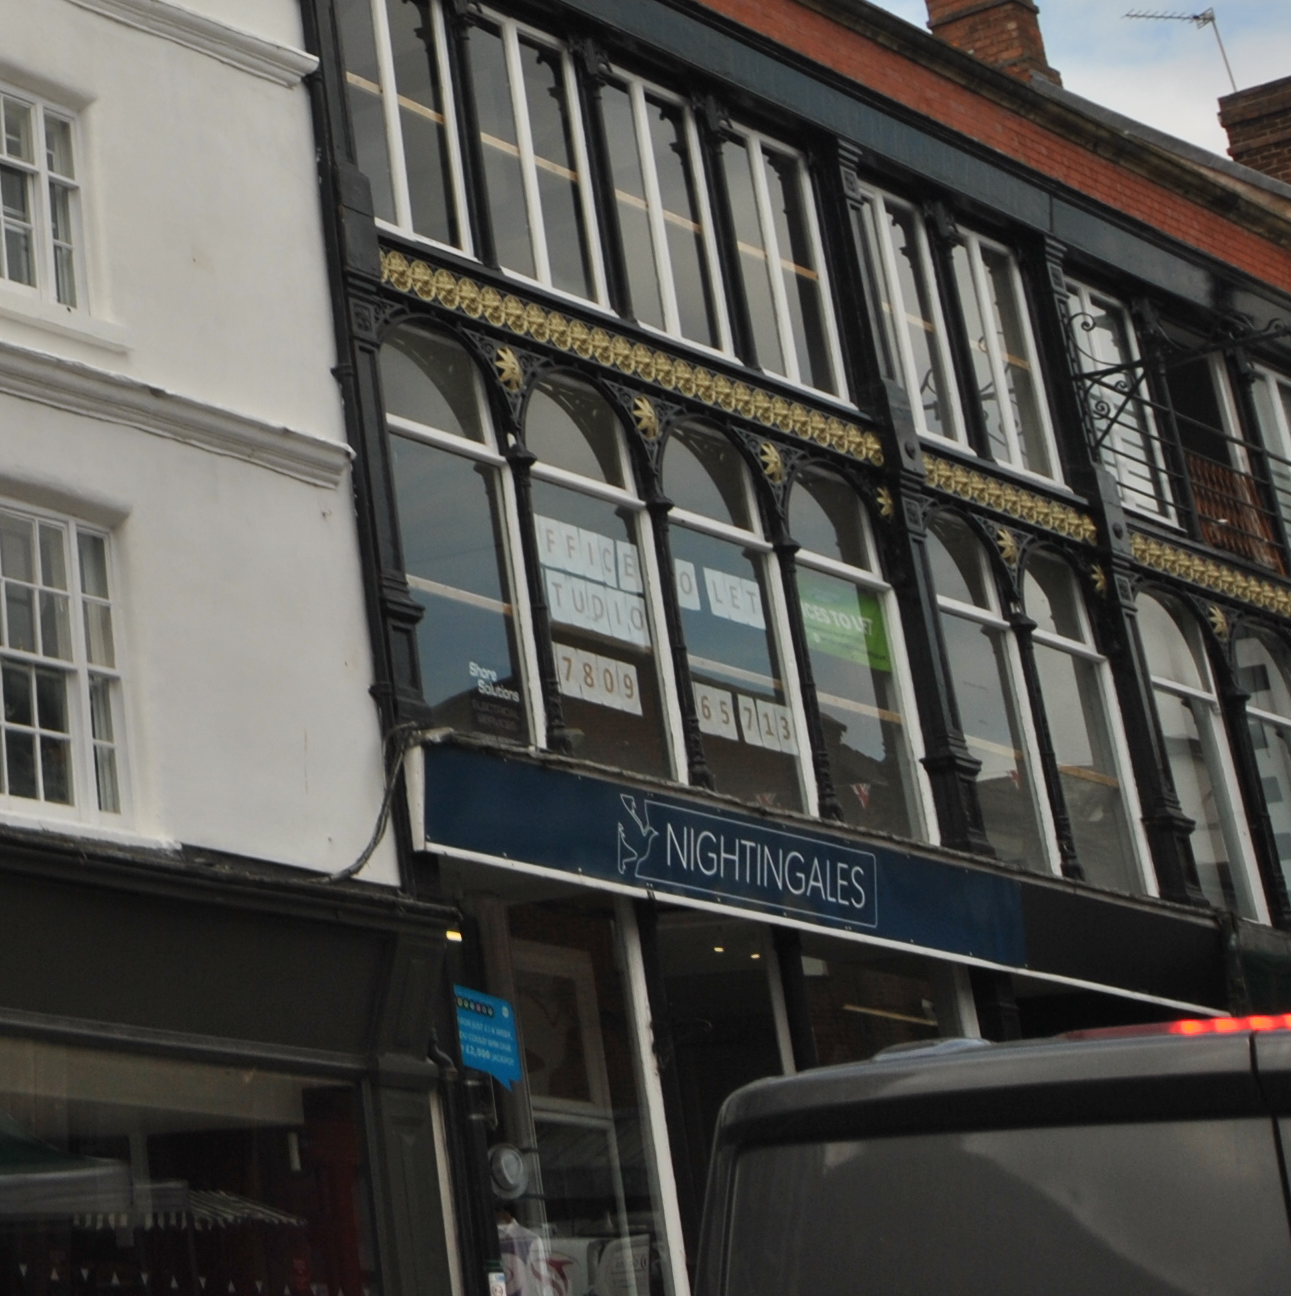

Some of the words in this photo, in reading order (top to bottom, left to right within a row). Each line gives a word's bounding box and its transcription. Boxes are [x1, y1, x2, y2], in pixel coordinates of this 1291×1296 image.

[545, 528, 635, 577] FFICE
[551, 582, 644, 632] TUDIO
[679, 571, 693, 596] O
[711, 580, 758, 615] LET
[830, 610, 851, 630] TO
[851, 615, 873, 636] LET
[478, 679, 520, 703] Solutions
[562, 656, 635, 699] 7809
[667, 822, 866, 909] NIGHTINGALES
